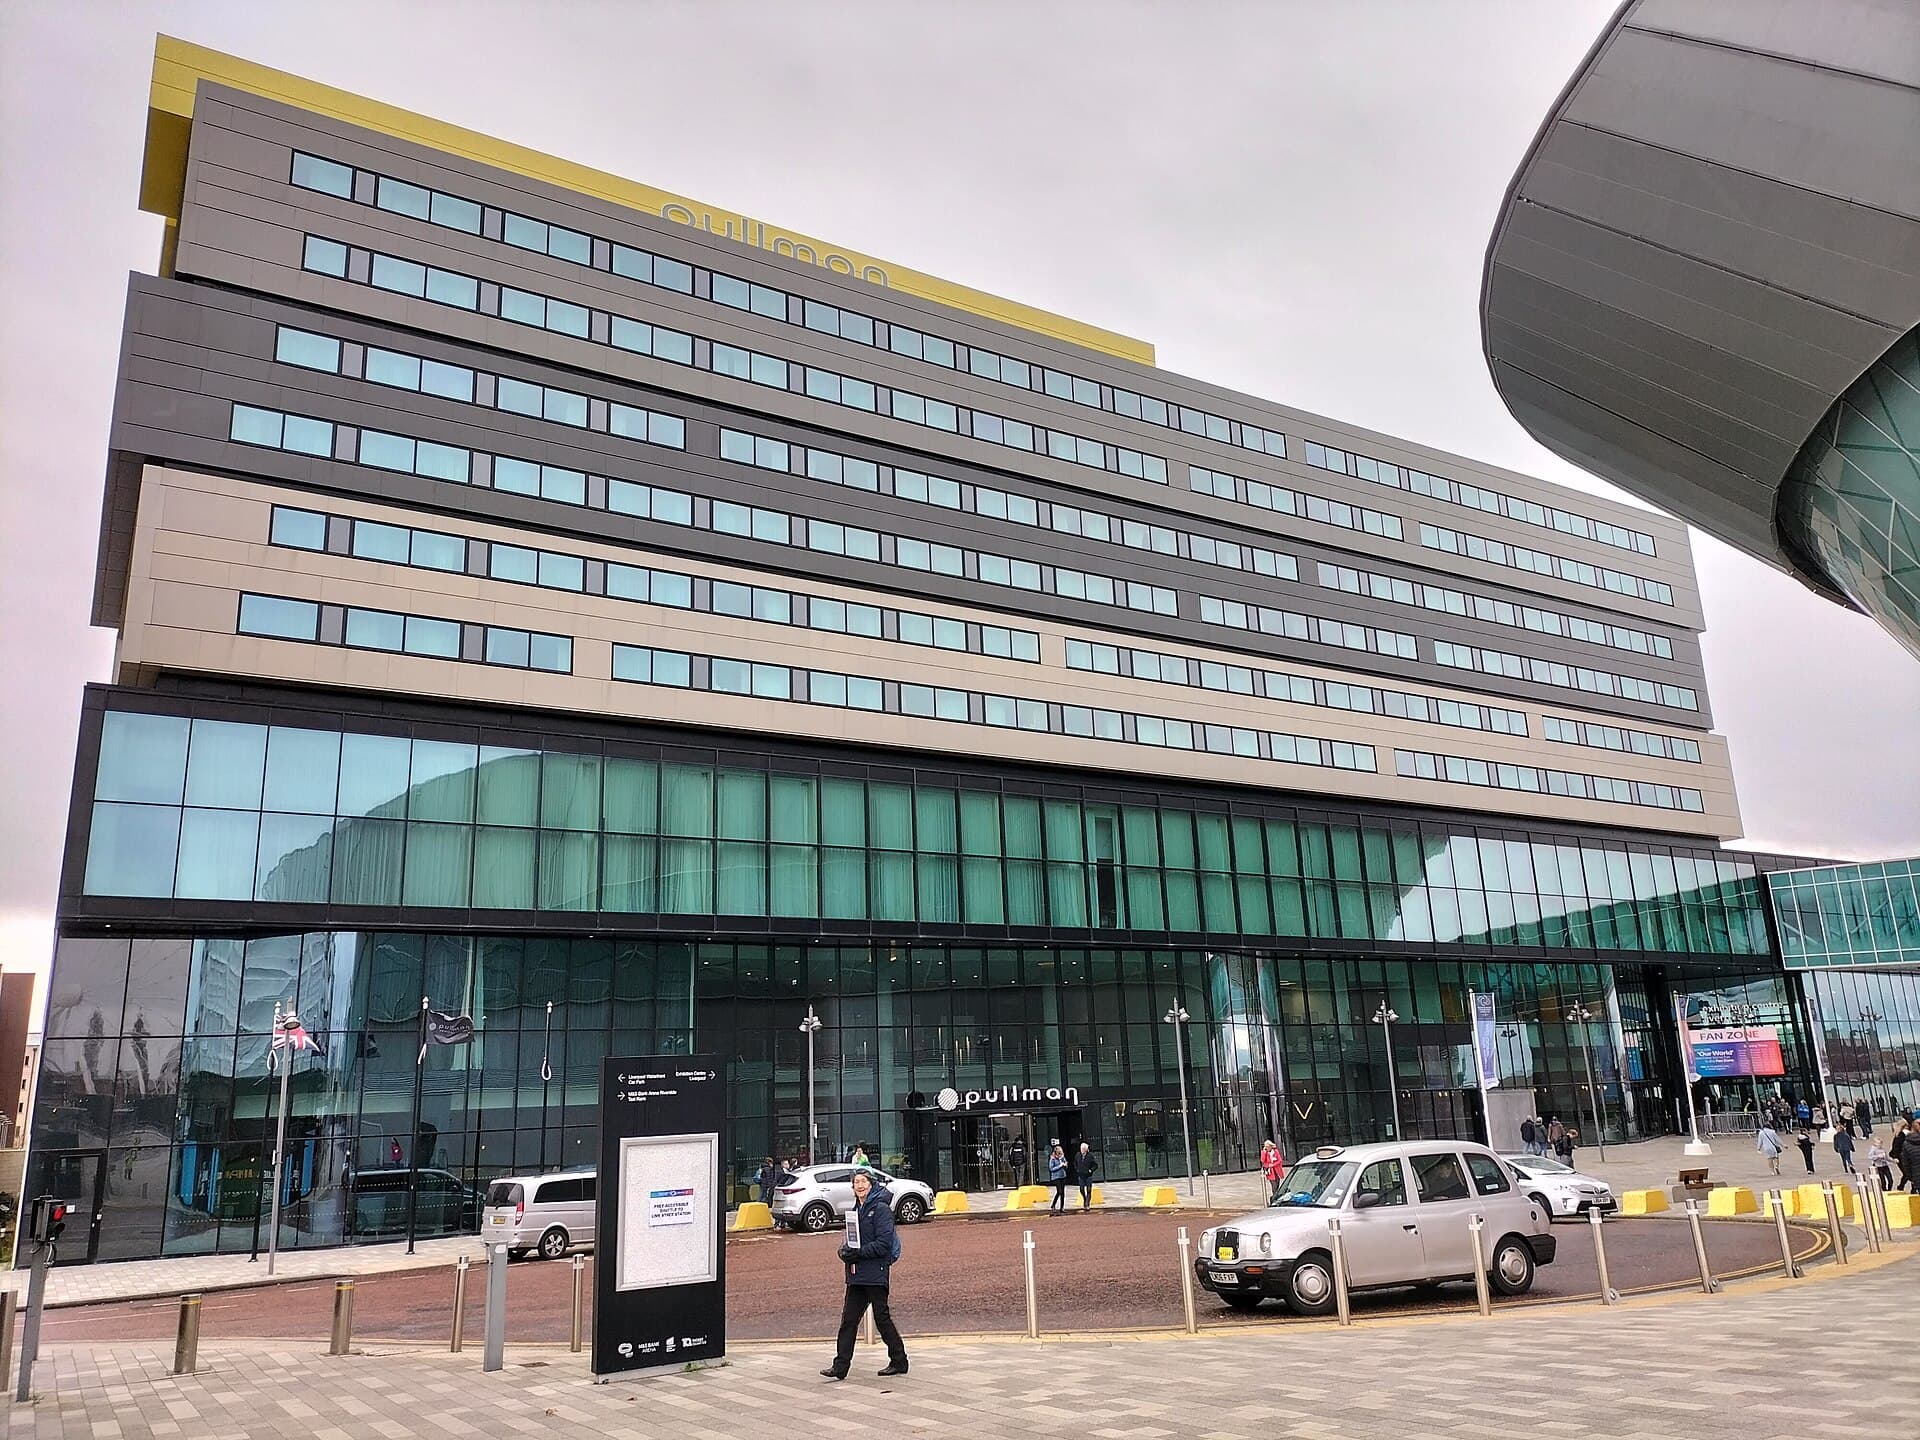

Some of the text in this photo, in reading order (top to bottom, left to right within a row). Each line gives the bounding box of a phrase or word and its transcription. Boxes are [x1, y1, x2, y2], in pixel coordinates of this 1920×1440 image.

[1700, 1030, 1760, 1041] FAN ZONE
[965, 1084, 1078, 1110] pullman
